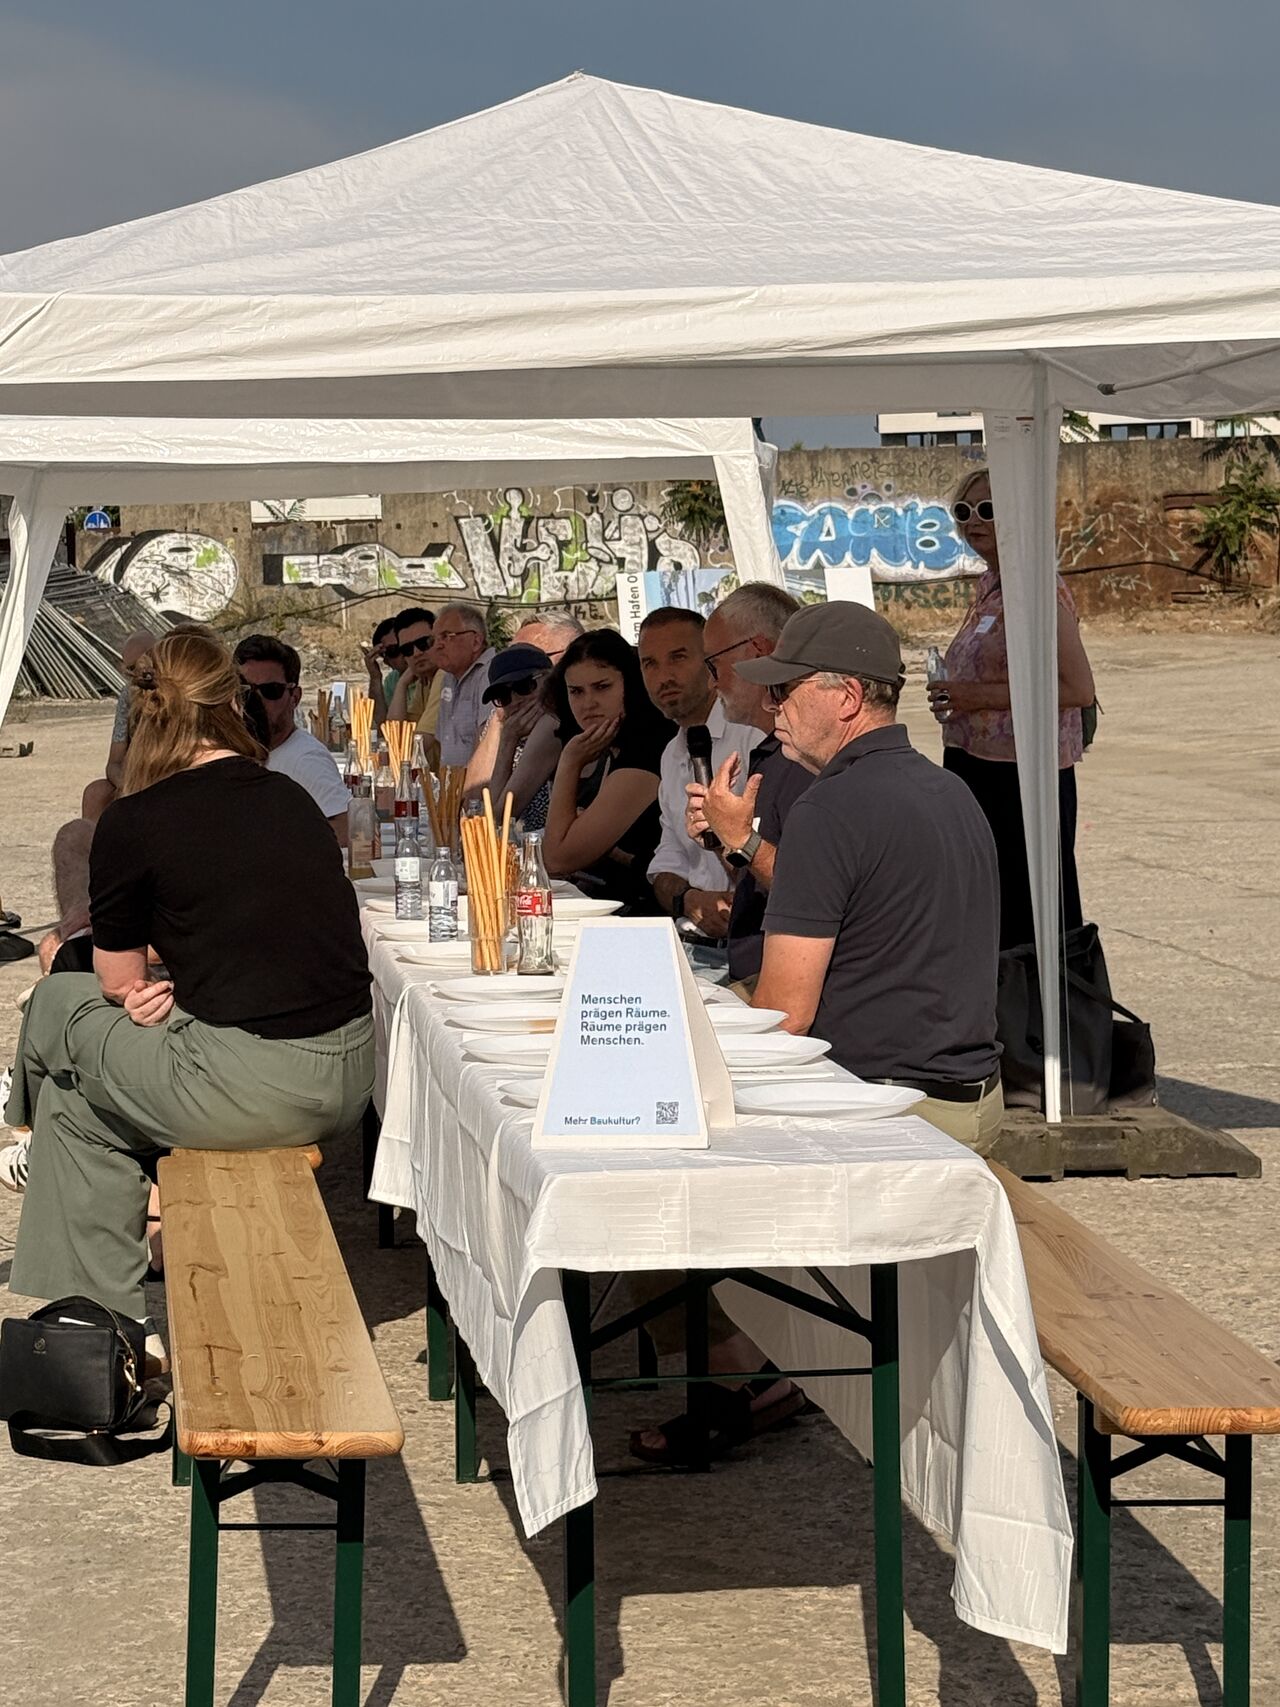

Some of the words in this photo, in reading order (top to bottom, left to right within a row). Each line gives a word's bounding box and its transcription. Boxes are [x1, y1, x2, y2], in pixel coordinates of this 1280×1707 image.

[628, 586, 641, 619] Hafen
[581, 994, 642, 1005] Menschen
[581, 1008, 622, 1021] prägen
[625, 1008, 671, 1019] Räume.
[580, 1021, 622, 1032] Räume
[625, 1022, 667, 1034] prägen
[580, 1034, 645, 1046] Menschen.
[564, 1116, 588, 1125] Mehr
[590, 1116, 641, 1126] Baukultur?
